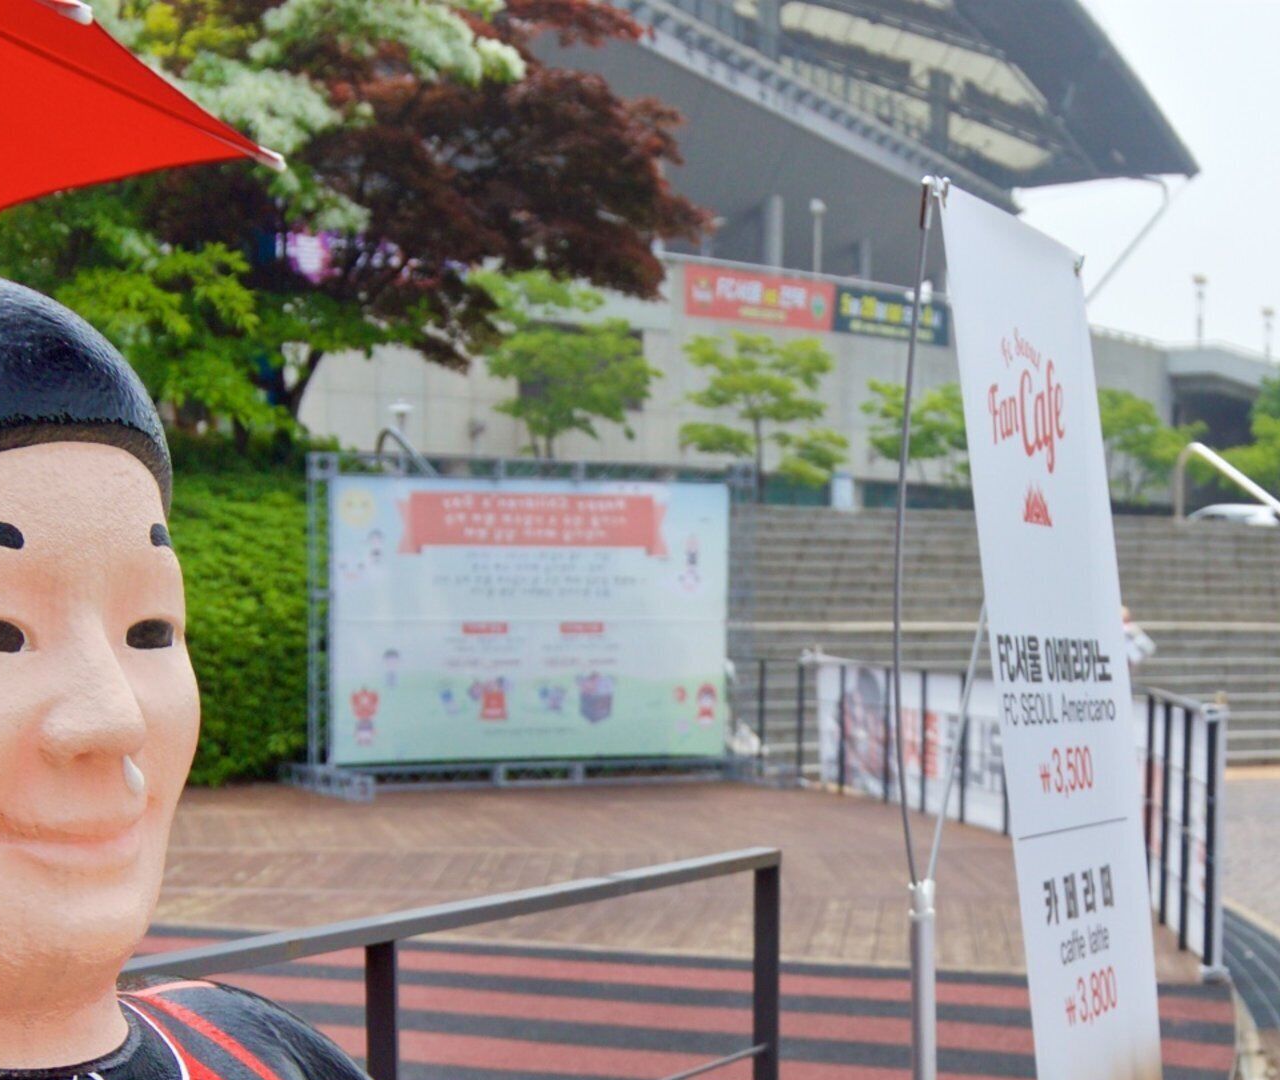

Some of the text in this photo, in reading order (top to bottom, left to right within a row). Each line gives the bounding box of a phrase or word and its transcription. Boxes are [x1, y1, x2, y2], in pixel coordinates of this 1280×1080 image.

[988, 359, 1064, 474] Fan Cafe
[997, 634, 1113, 683] FC서울 아메리카노
[1003, 692, 1116, 726] FC SEOUL Americano
